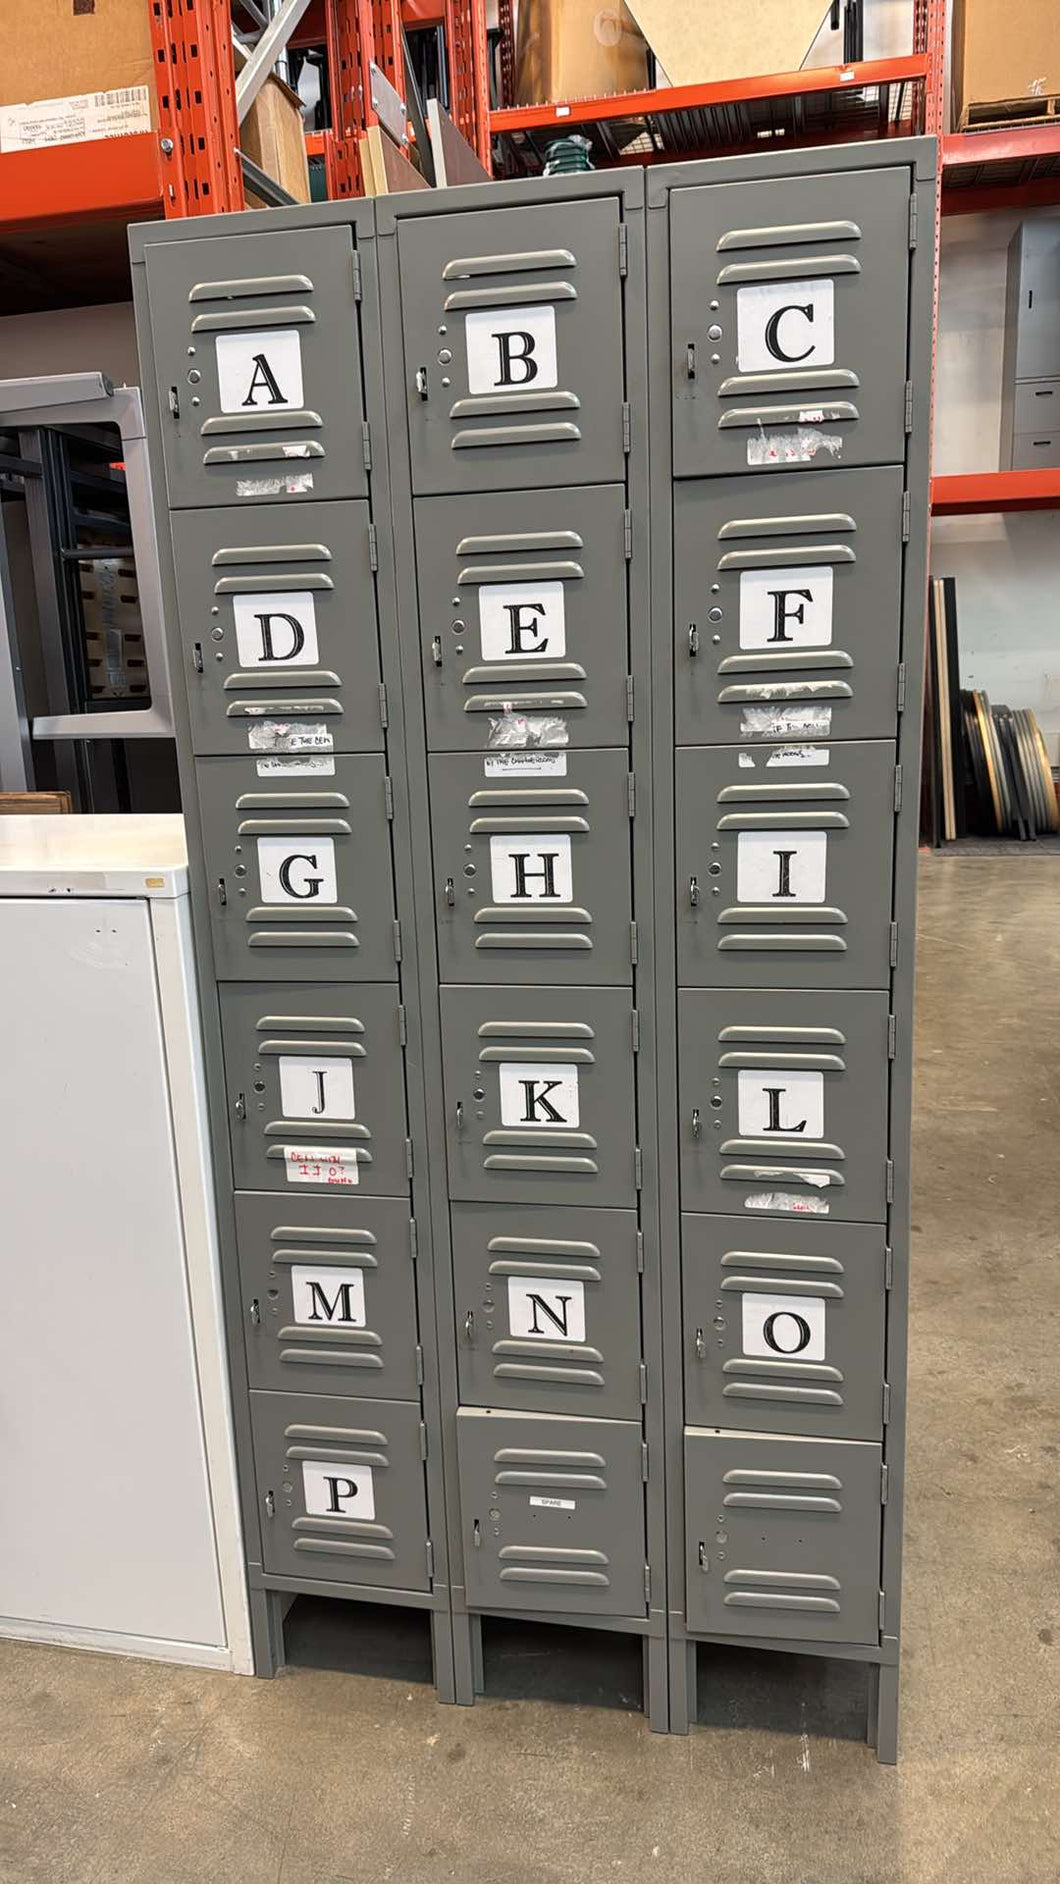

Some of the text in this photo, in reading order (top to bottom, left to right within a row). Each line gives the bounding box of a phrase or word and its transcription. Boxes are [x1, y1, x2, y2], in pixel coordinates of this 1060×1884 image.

[764, 303, 816, 363] C
[241, 353, 289, 405] A
[491, 331, 538, 387] B
[253, 613, 305, 660] D
[502, 603, 549, 655] E
[766, 588, 814, 643] F
[279, 854, 324, 899] G
[508, 853, 561, 897] H
[772, 850, 798, 895] I
[311, 1071, 328, 1114] J
[518, 1080, 566, 1121] K
[762, 1087, 807, 1131] L
[305, 1281, 355, 1319] M
[525, 1293, 572, 1335] N
[762, 1311, 811, 1353] O
[323, 1476, 358, 1513] P
